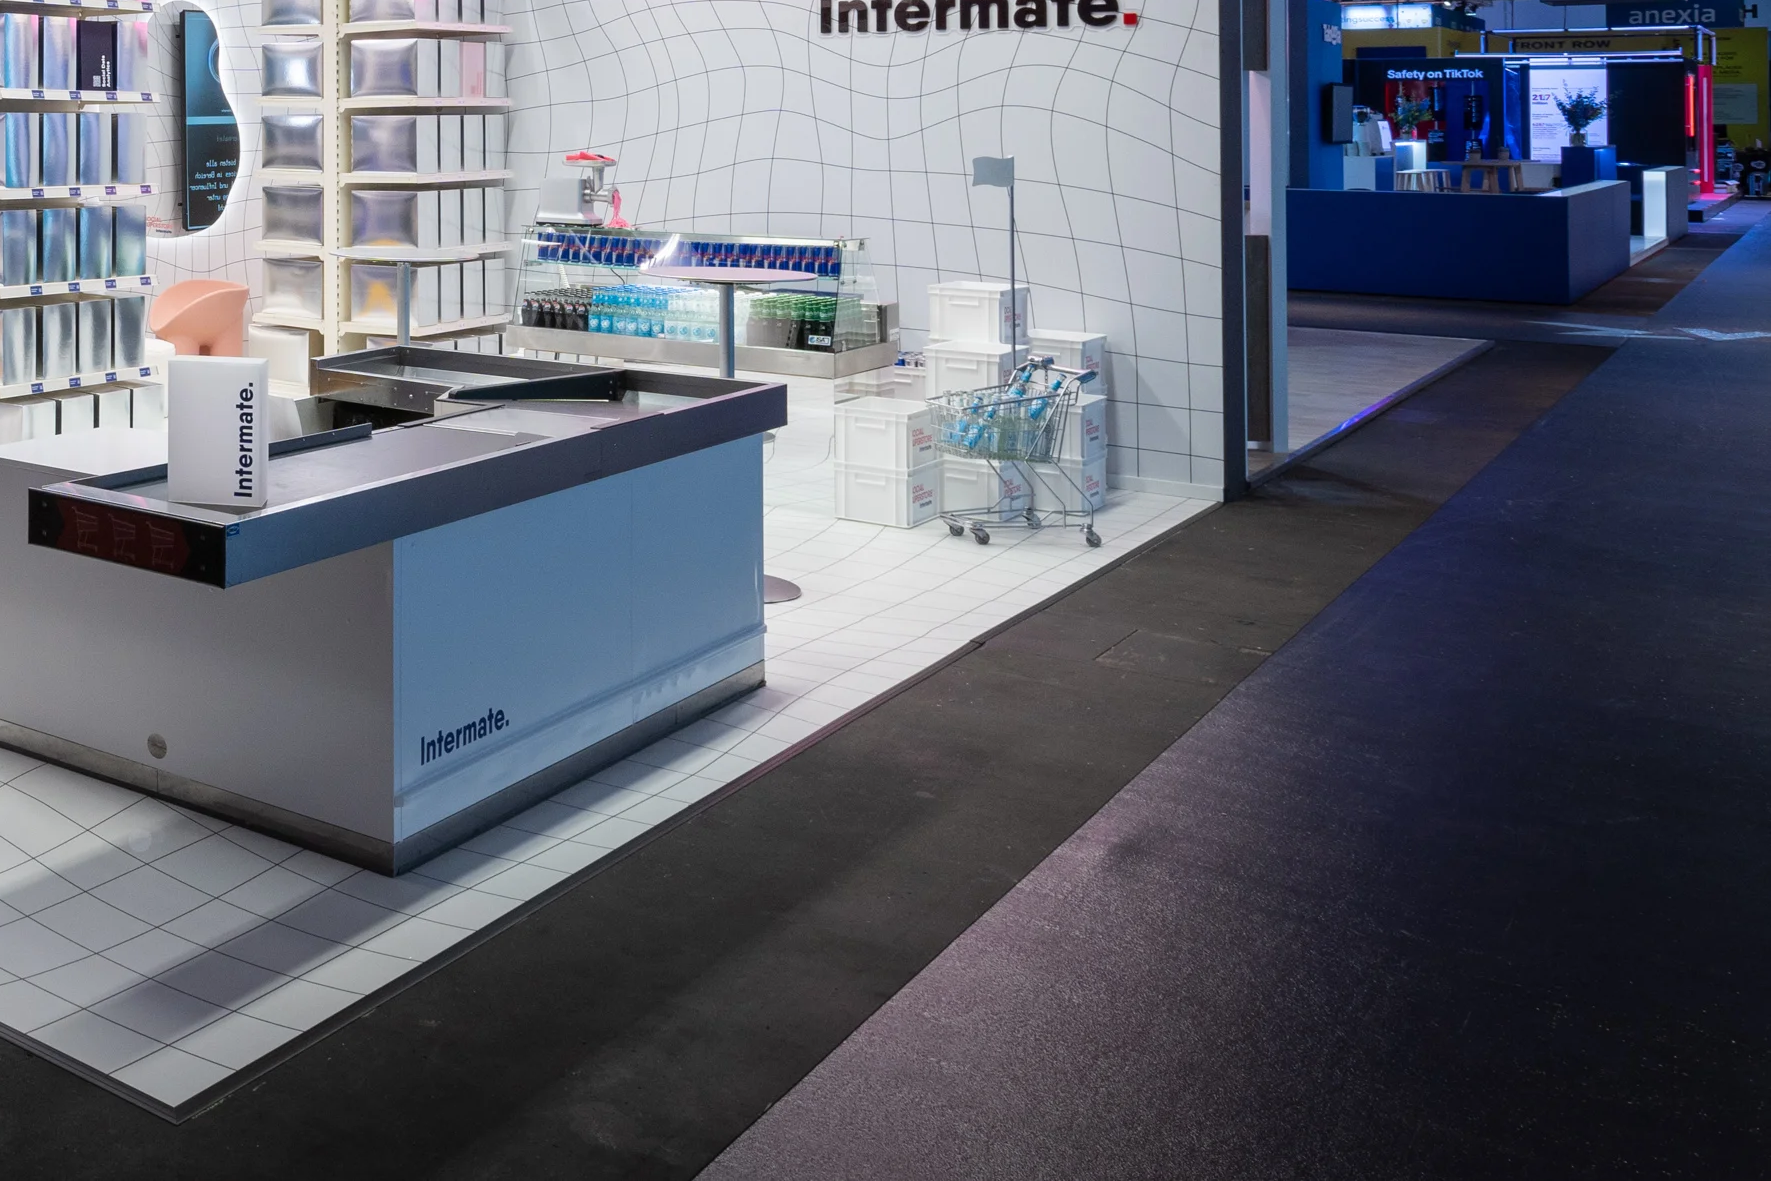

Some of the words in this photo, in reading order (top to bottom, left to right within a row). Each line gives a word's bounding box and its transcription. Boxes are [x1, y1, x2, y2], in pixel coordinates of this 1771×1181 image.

[1628, 4, 1716, 25] anexia
[1516, 38, 1569, 50] FRONT
[1572, 39, 1611, 49] ROW
[1386, 69, 1424, 81] Safety
[1426, 71, 1442, 79] on
[1443, 69, 1484, 79] TikTok
[234, 381, 254, 498] Intermate.
[420, 707, 510, 766] Intermate.
